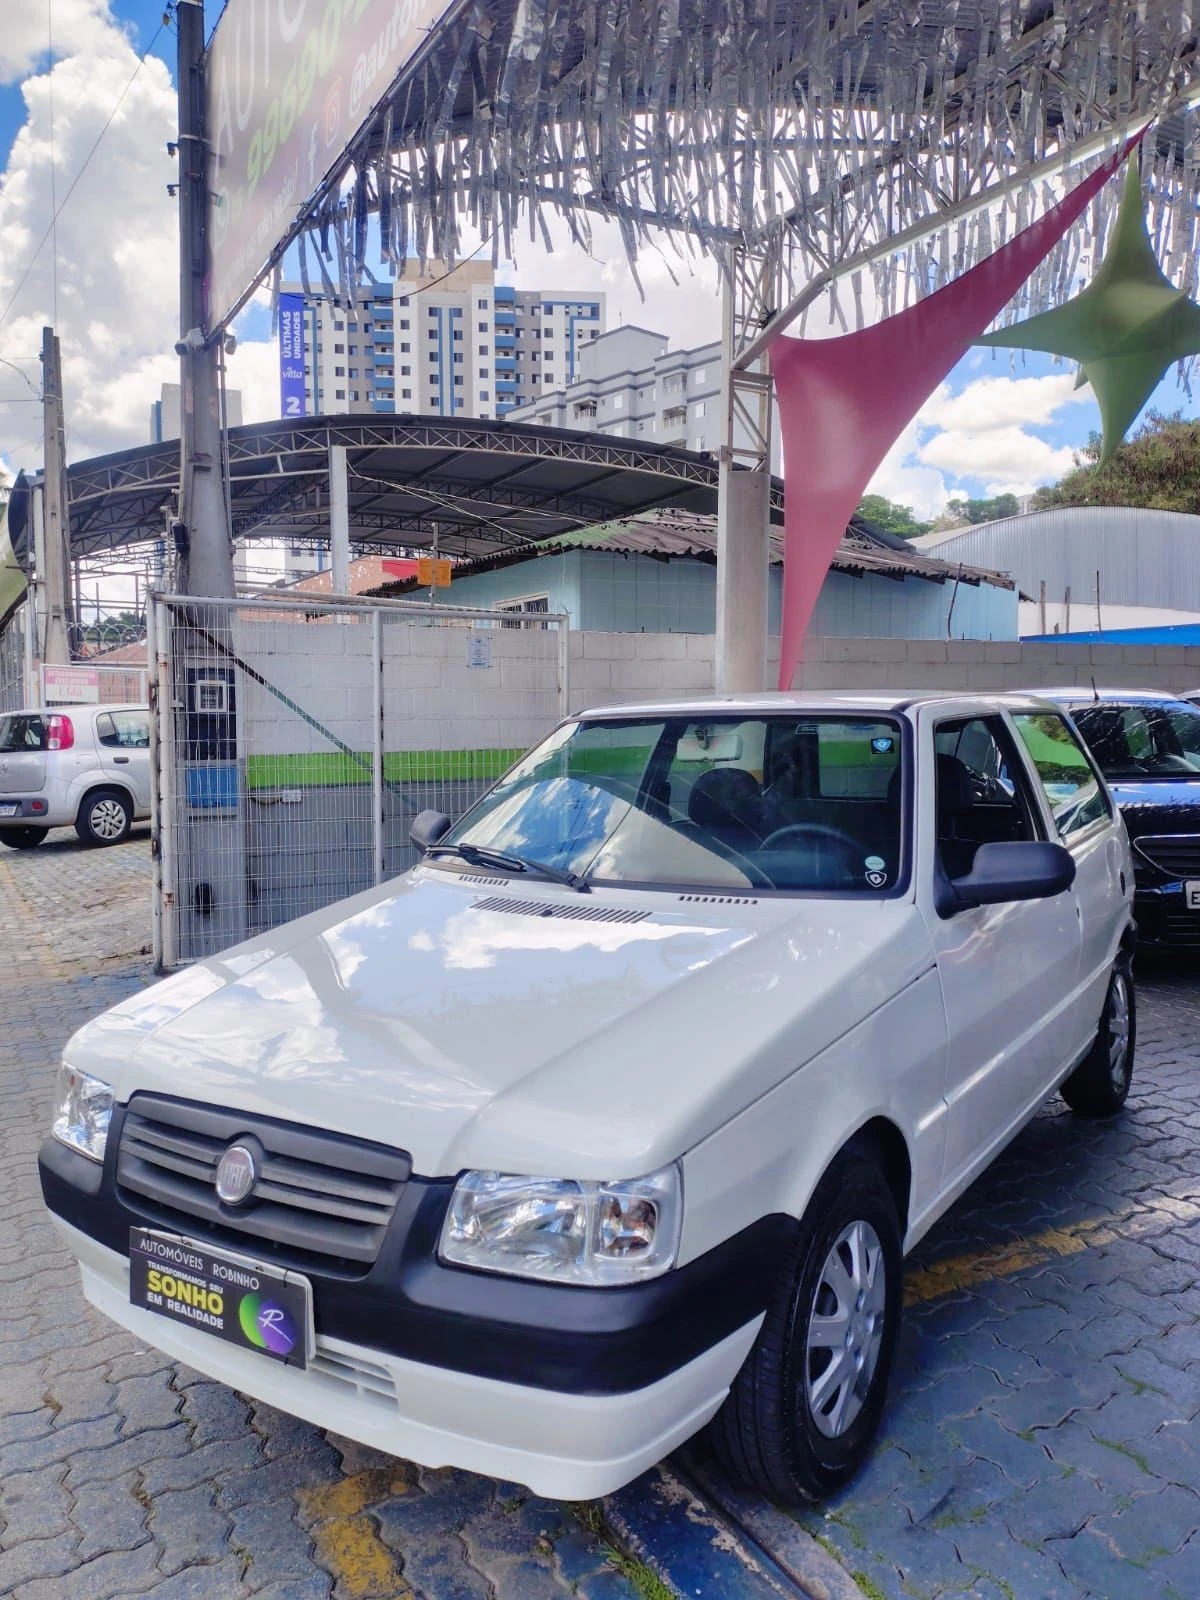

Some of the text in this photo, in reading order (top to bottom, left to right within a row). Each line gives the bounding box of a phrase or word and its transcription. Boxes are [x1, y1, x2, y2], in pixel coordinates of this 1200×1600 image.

[282, 311, 292, 358] ÚLTIMAS
[293, 311, 301, 359] UNIDADES
[286, 396, 300, 414] 2
[140, 1238, 260, 1290] AUTOMÓVEIS ROBINHO
[147, 1261, 224, 1295] TRANSFORMAMOS SEU
[147, 1292, 224, 1330] EM REALIDADE
[148, 1270, 224, 1315] SONHO
